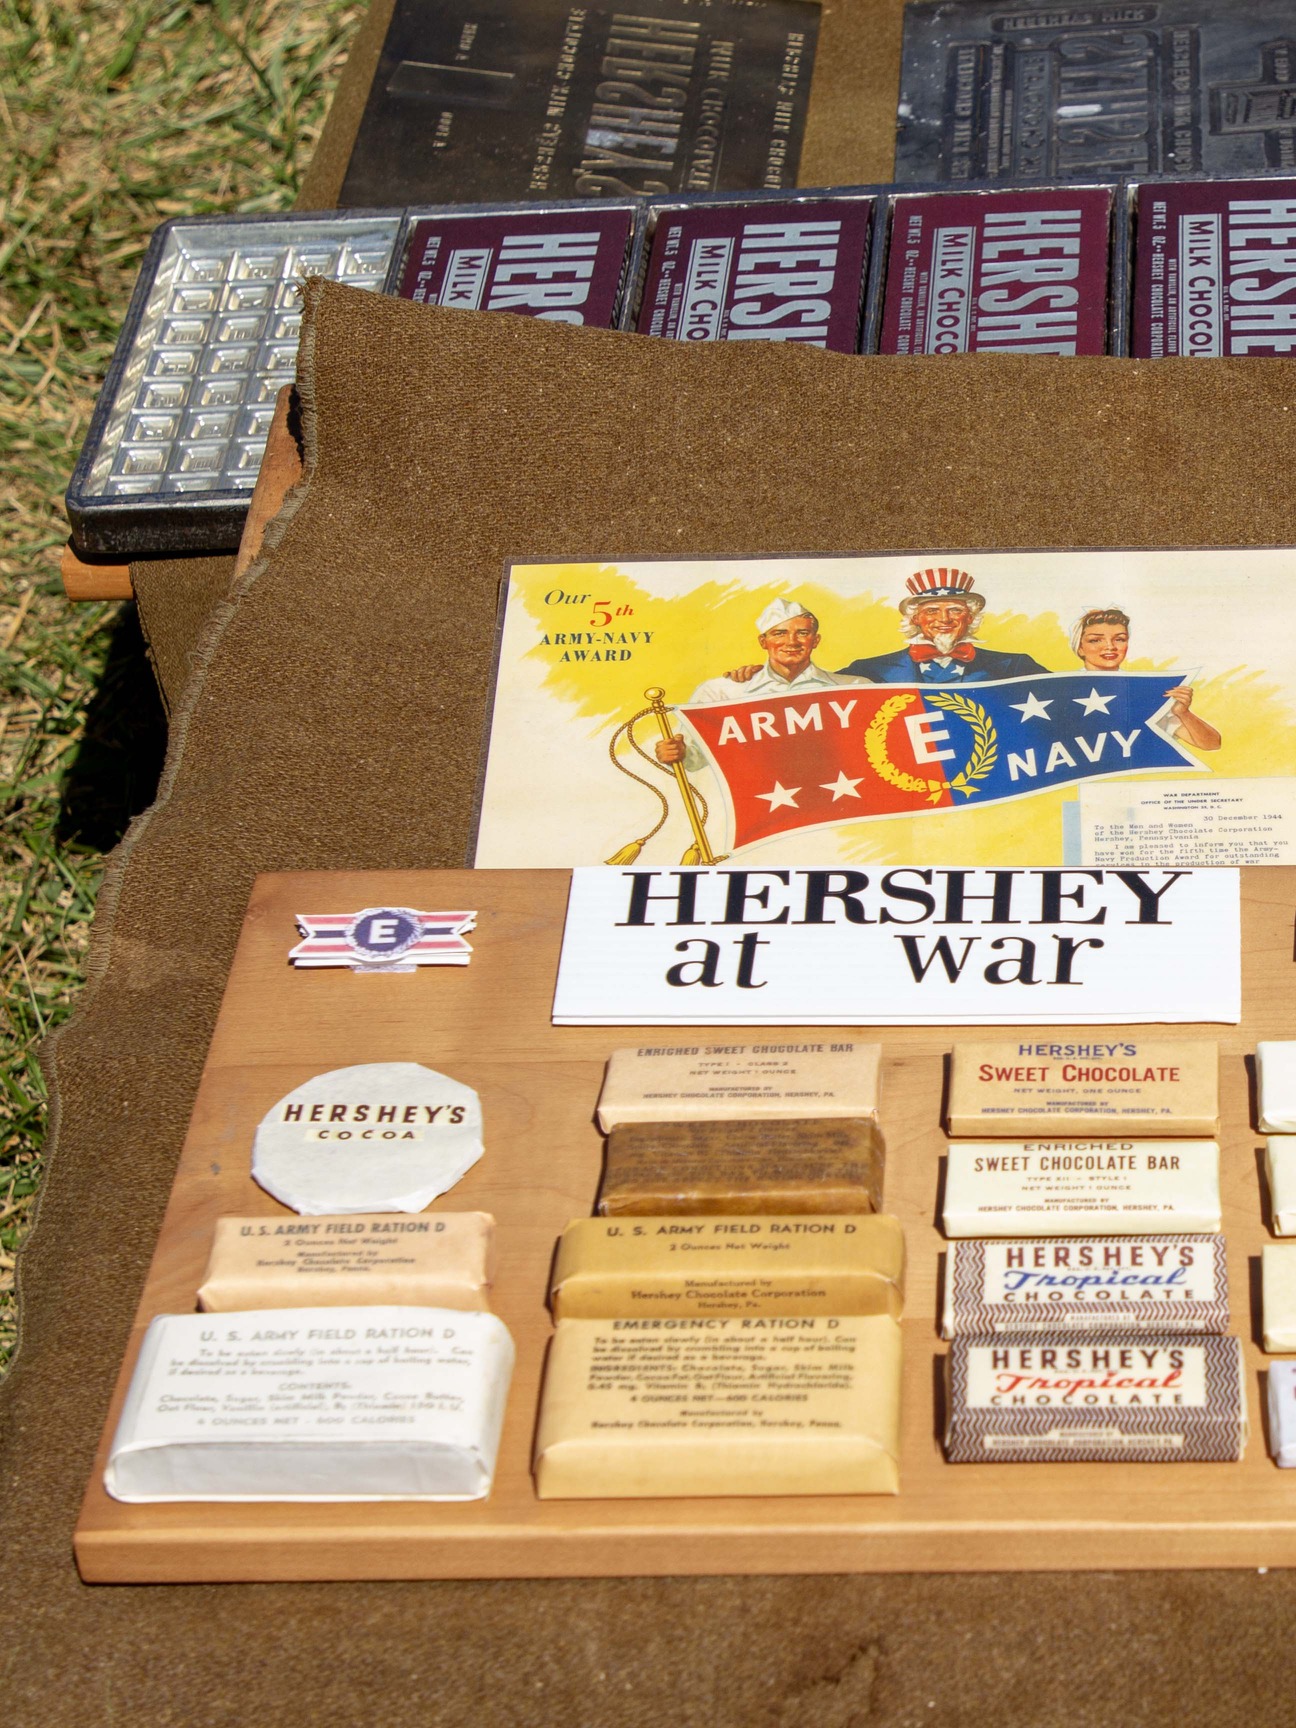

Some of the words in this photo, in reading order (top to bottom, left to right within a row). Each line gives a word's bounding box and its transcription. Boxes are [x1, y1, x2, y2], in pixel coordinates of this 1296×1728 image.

[1189, 221, 1214, 267] MILK
[940, 233, 969, 279] MILK
[448, 255, 484, 300] MILK
[694, 245, 727, 290] MILK
[543, 589, 592, 607] Our
[589, 600, 635, 628] 5th
[539, 631, 655, 646] ARMY-NAVY
[558, 649, 633, 664] AWARD
[718, 699, 858, 746] ARMY
[904, 710, 957, 765] E
[1007, 729, 1142, 782] NAVY
[1217, 826, 1273, 834] Corporation
[615, 868, 1193, 928] HERSHEY
[369, 918, 401, 944] E
[664, 931, 771, 990] at
[894, 933, 1105, 986] war
[637, 1046, 700, 1057] ENRICHED
[704, 1045, 747, 1056] SWEET
[752, 1044, 824, 1054] CHOCOLATE
[830, 1042, 855, 1053] BAR
[1018, 1042, 1137, 1058] HERSHEY'S
[977, 1063, 1050, 1083] SWEET
[1061, 1063, 1180, 1083] CHOCOLATE
[283, 1104, 466, 1124] HERSHEY'S
[318, 1129, 416, 1140] COCOA
[1023, 1143, 1134, 1152] ENRICHED
[974, 1156, 1030, 1172] SWEET
[1040, 1155, 1137, 1171] CHOCOLATE
[1148, 1155, 1180, 1171] BAR
[274, 1223, 319, 1236] ARMY
[325, 1223, 366, 1234] FIELD
[370, 1222, 429, 1234] RATION
[434, 1221, 446, 1233] D
[656, 1225, 704, 1236] ARMY
[714, 1223, 761, 1235] FIELD
[770, 1223, 834, 1234] RATION
[844, 1223, 858, 1234] D
[1006, 1244, 1195, 1269] HERSHEY'S
[1003, 1266, 1187, 1290] Tropical
[1003, 1289, 1195, 1304] CHOCOLATE
[250, 1329, 299, 1341] ARMY
[308, 1328, 356, 1341] FIELD
[365, 1327, 434, 1340] RATION
[442, 1327, 456, 1339] D
[612, 1319, 730, 1331] EMERGENCY
[741, 1319, 815, 1330] RATION
[827, 1318, 840, 1330] D
[991, 1348, 1184, 1371] HERSHEY'S
[995, 1368, 1183, 1395] Tropical
[990, 1394, 1183, 1407] CHOCOLATE
